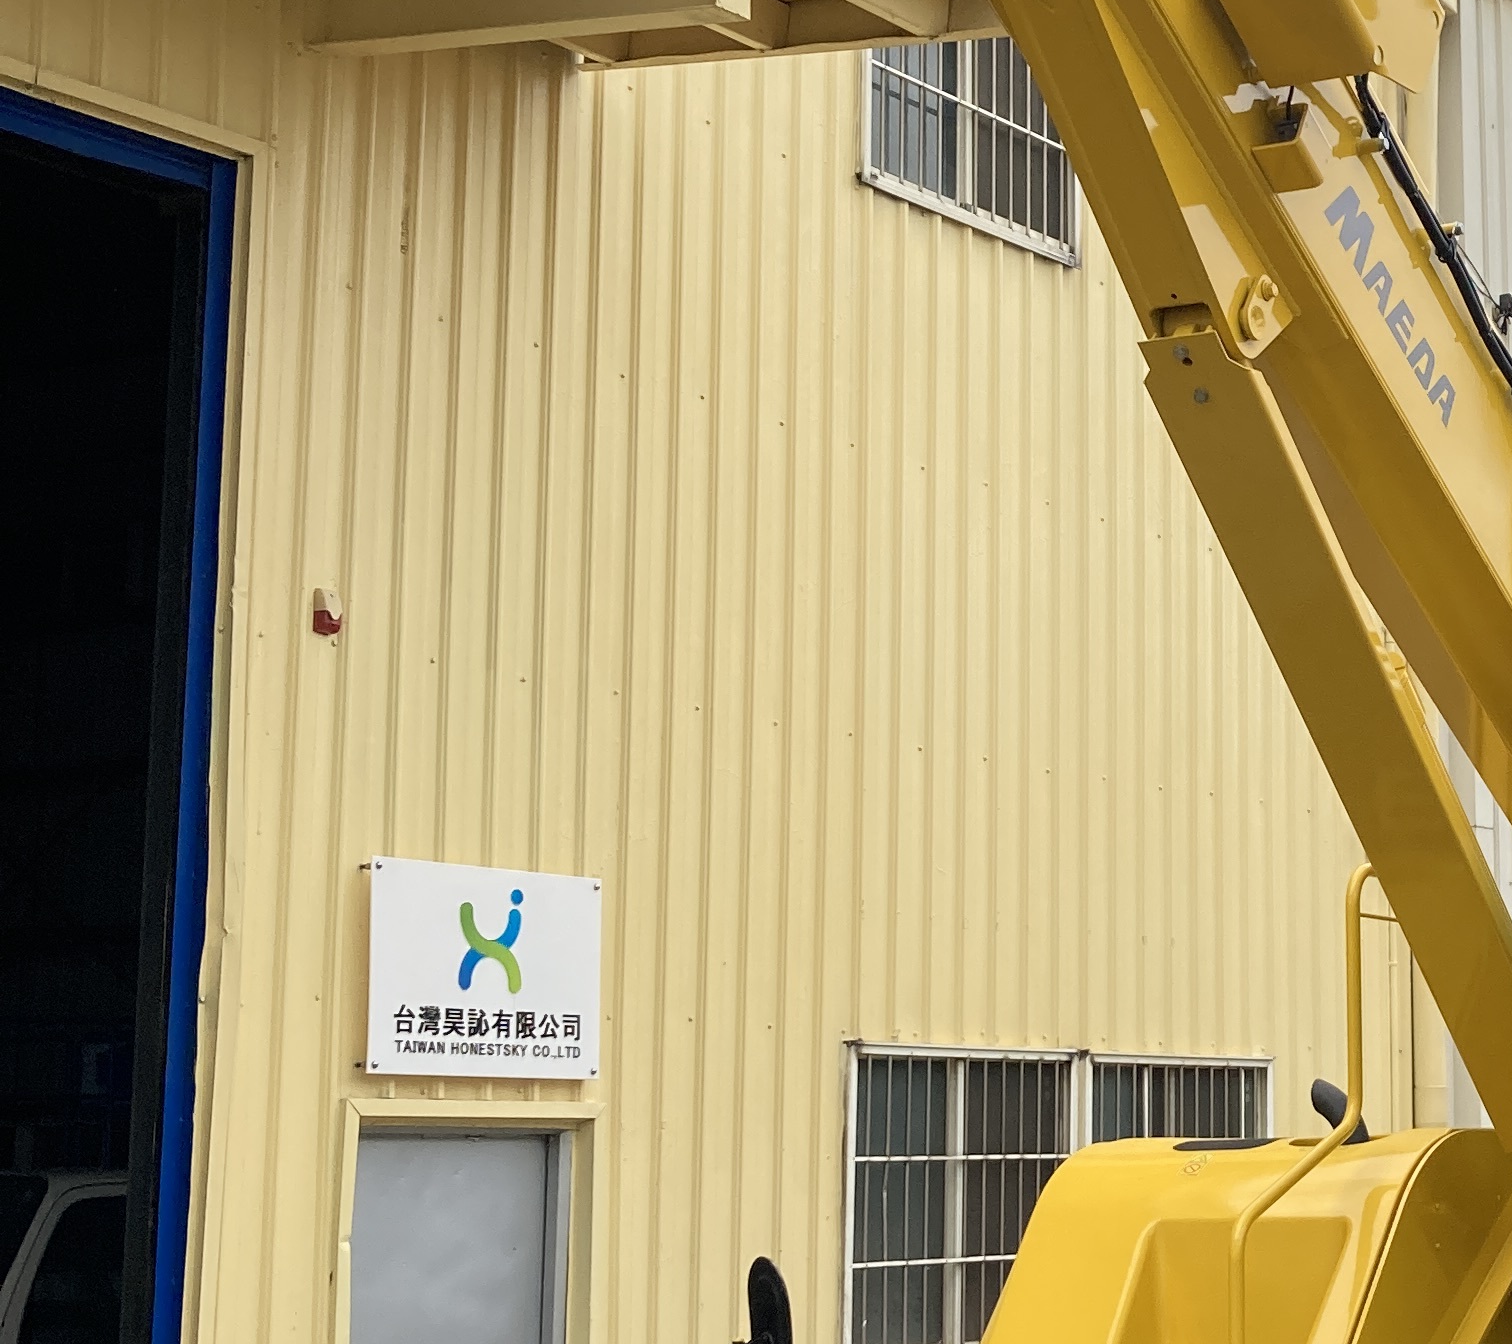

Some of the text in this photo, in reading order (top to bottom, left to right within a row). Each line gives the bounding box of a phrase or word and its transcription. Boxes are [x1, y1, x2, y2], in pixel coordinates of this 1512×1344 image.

[1324, 185, 1456, 428] MAEDA
[394, 1040, 446, 1054] TAIWAN
[450, 1042, 528, 1057] HONESTSKY
